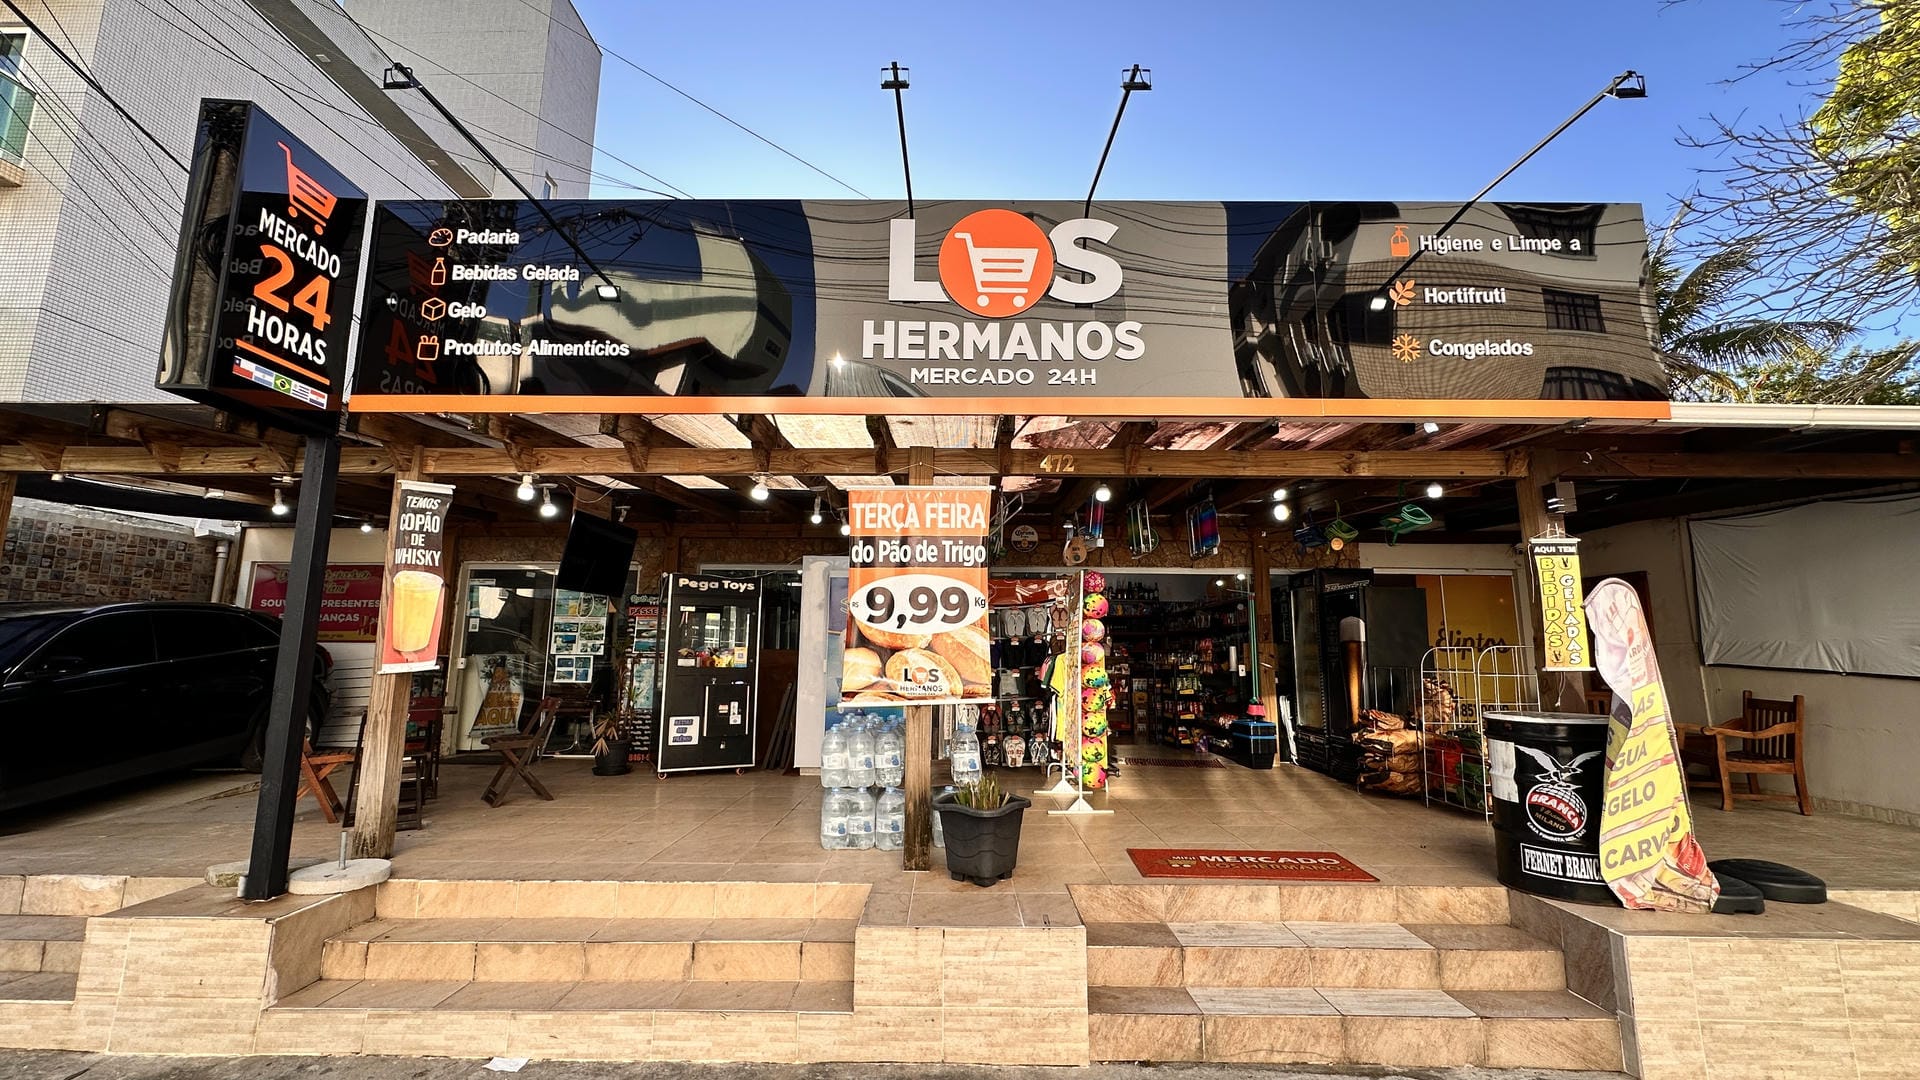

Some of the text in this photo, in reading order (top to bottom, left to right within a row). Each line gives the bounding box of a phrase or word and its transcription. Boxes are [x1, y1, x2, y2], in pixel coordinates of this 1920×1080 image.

[259, 207, 341, 278] MERCADO
[456, 228, 520, 245] Padaria
[1418, 235, 1582, 255] Higiene e Limpe a
[452, 264, 580, 281] Bebidas Gelada
[253, 244, 332, 331] 24
[1424, 287, 1506, 304] Hortifruti
[447, 302, 487, 319] Gelo
[247, 304, 328, 365] HORAS
[862, 320, 1146, 361] HERMANOS
[444, 339, 631, 357] Produtos Alimentícios
[1429, 338, 1534, 360] Congelados
[909, 367, 1097, 386] MERCADO 24H
[1039, 454, 1075, 473] 472
[406, 495, 442, 510] TEMOS
[400, 511, 441, 533] COPÃO
[852, 502, 987, 533] TERÇA FEIRA
[411, 533, 426, 547] DE
[395, 548, 442, 567] WHISKY
[851, 539, 987, 567] do Pão de Trigo
[1534, 546, 1556, 554] AQUI
[678, 578, 755, 593] Pega Toys
[321, 599, 381, 608] PRESENTES
[865, 586, 970, 629] 9,99
[974, 596, 987, 609] Kg
[1540, 557, 1565, 647] BEBIDAS
[1559, 574, 1583, 665] GELADAS
[1607, 780, 1656, 817] GELO
[1531, 794, 1580, 828] BRANCA
[1534, 812, 1566, 831] MILANO
[1199, 855, 1342, 865] MERCADO
[1524, 848, 1603, 881] FERNET BRANC
